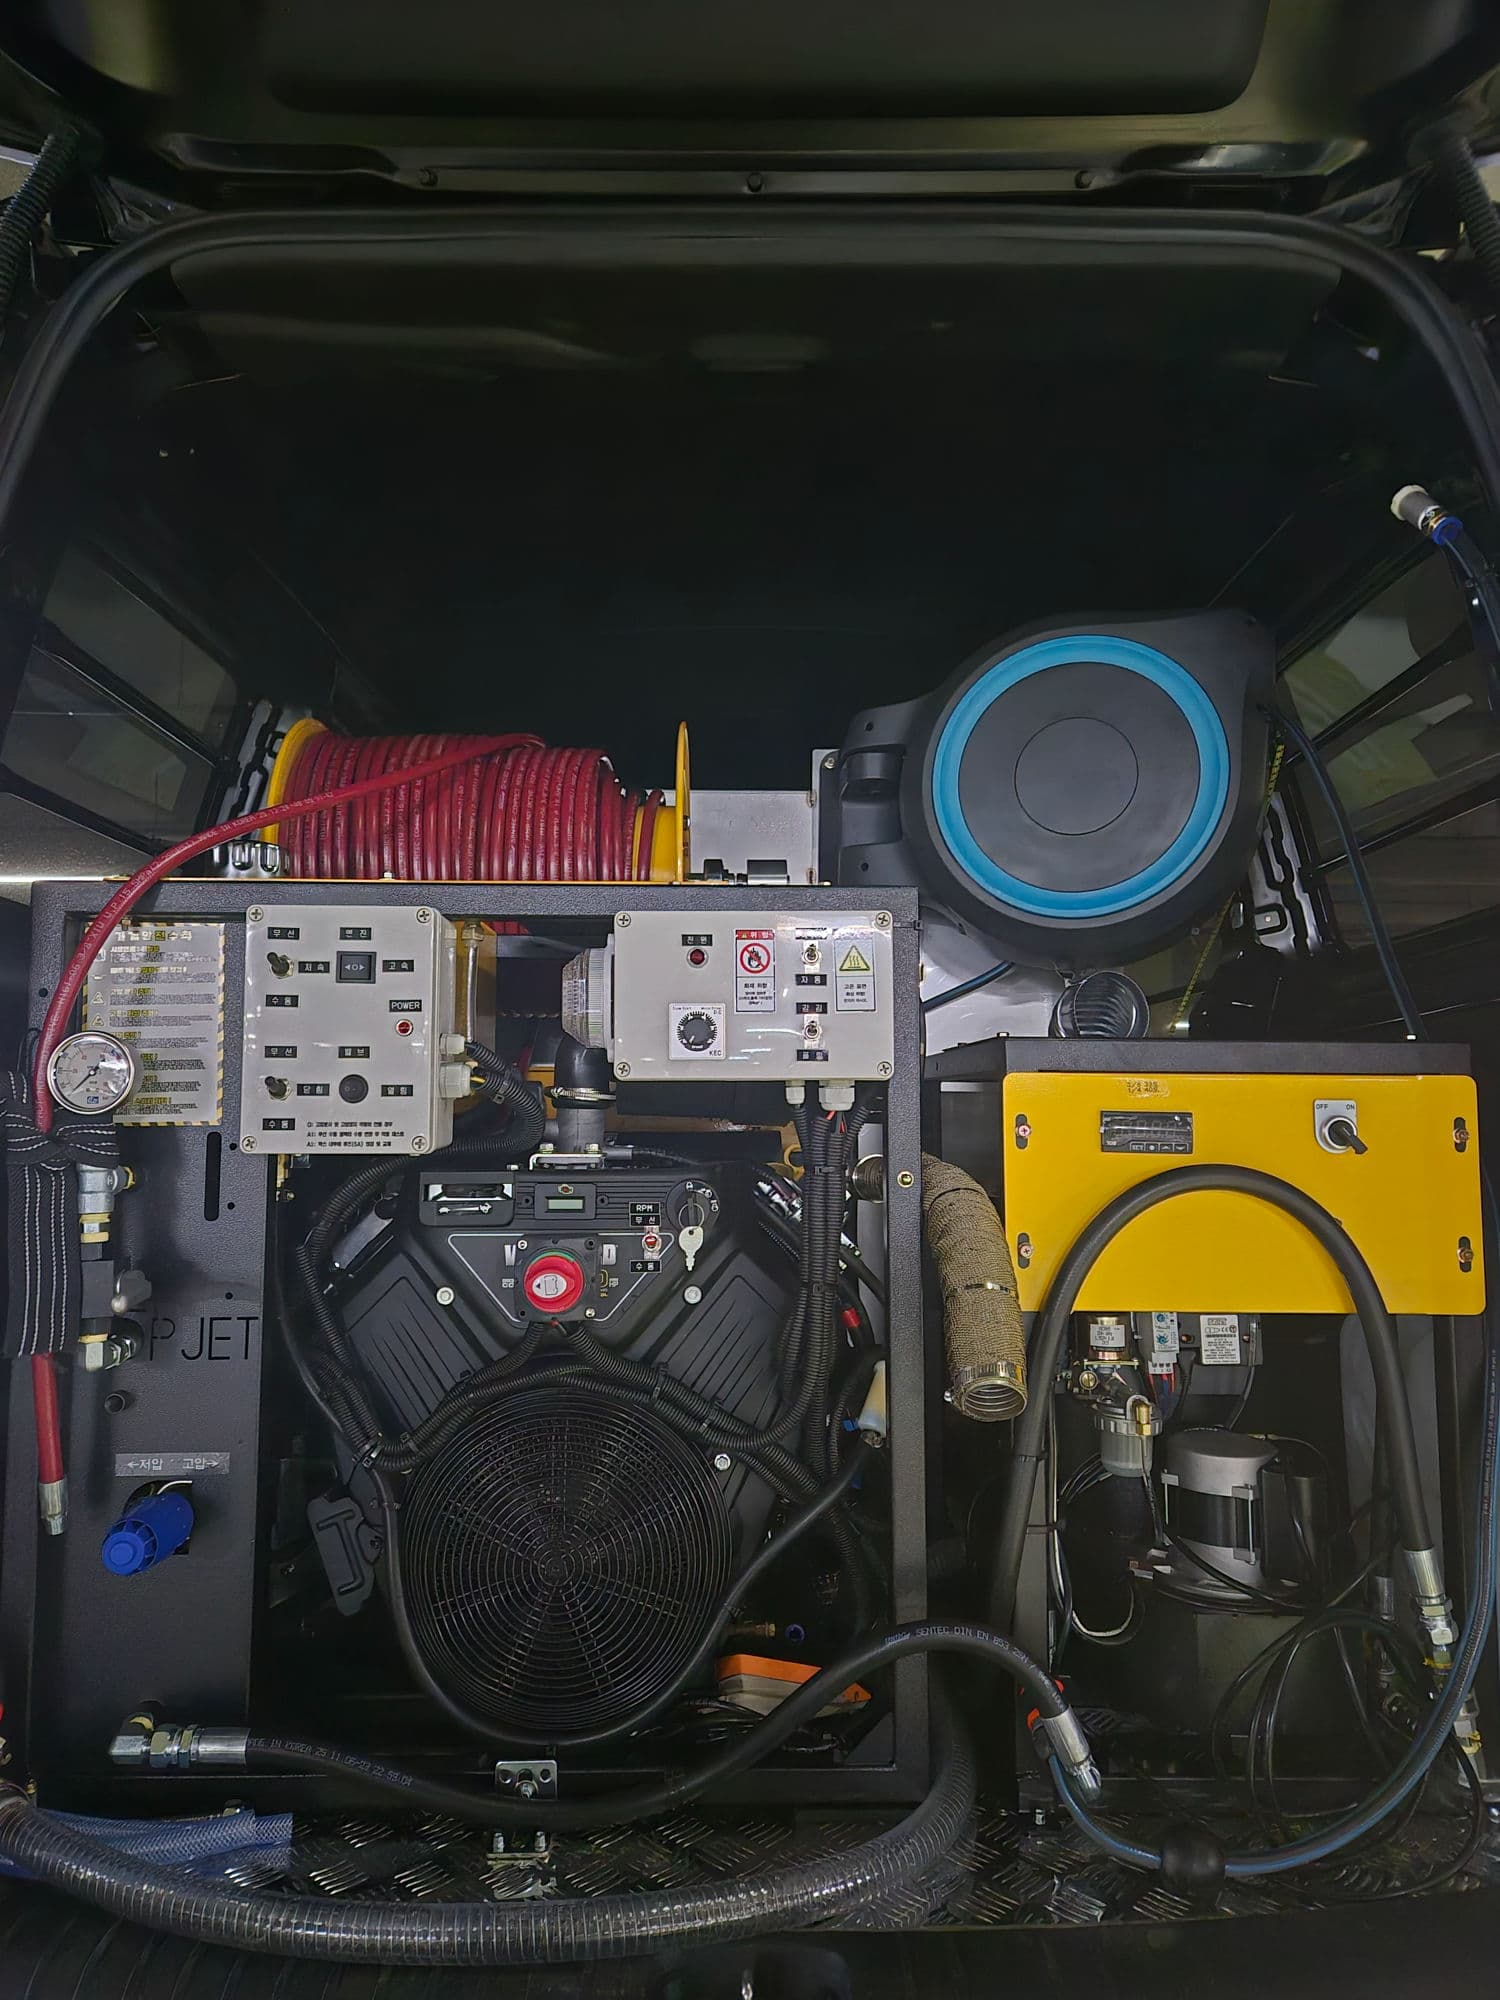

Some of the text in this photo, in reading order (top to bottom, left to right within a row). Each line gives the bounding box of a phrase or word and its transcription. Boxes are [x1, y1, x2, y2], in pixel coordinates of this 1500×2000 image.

[391, 1001, 421, 1010] POWER
[635, 1204, 654, 1212] RPM
[181, 1316, 259, 1361] JET
[138, 1457, 207, 1471] 저압 고압
[953, 1625, 973, 1638] DIN
[976, 1630, 990, 1641] EN
